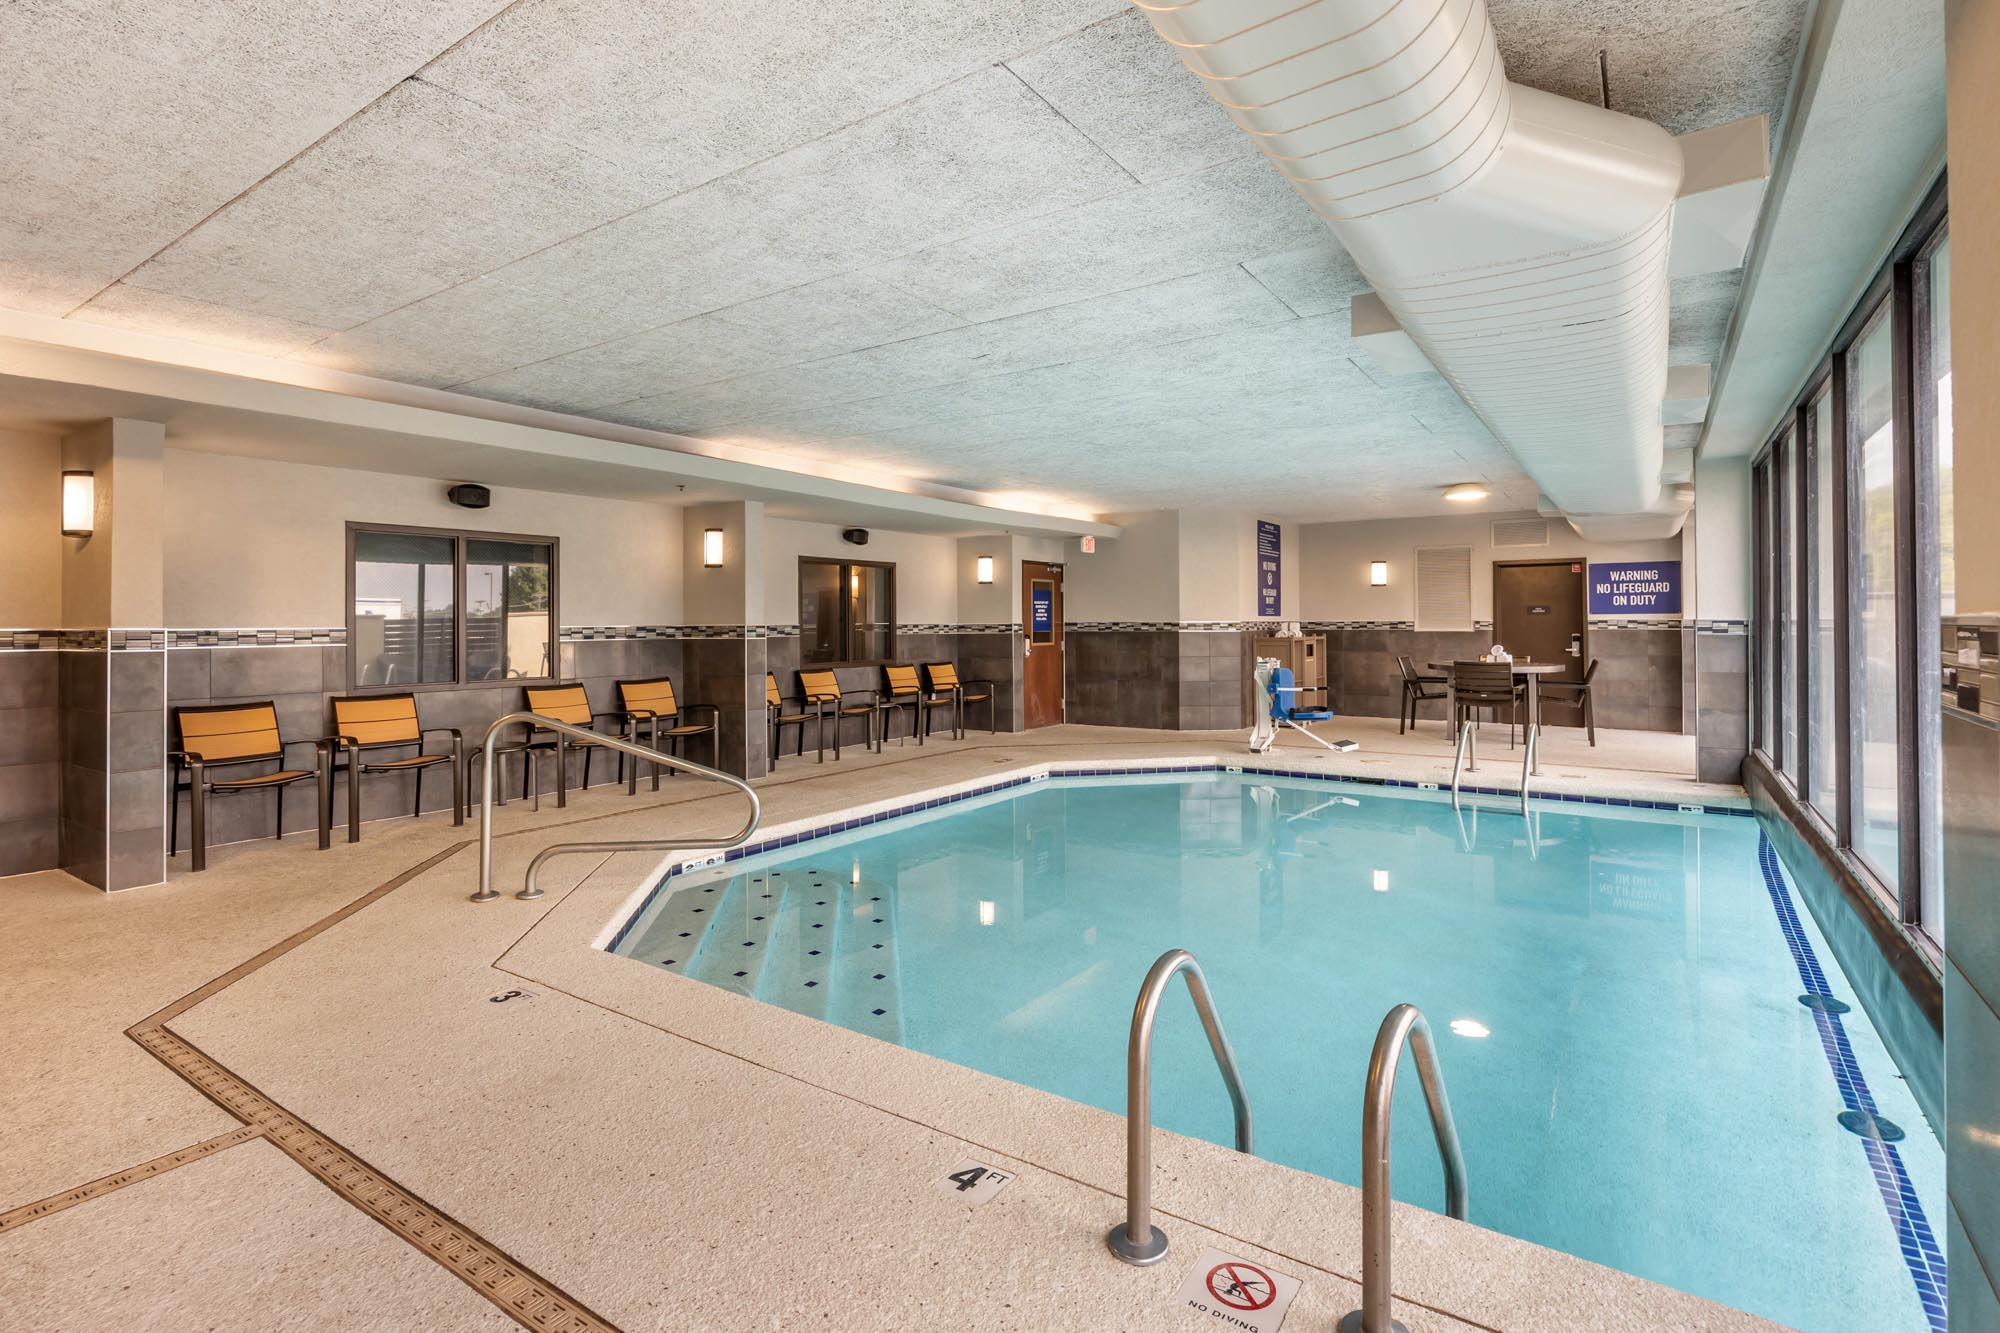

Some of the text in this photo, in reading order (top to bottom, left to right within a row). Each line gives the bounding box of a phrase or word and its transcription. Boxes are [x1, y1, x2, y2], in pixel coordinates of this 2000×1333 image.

[1610, 570, 1659, 581] WARNING
[1596, 582, 1670, 594] NO LIFEGUARD
[1613, 594, 1657, 606] ON DUTY
[489, 991, 522, 1003] 3
[947, 1166, 1010, 1192] 4 FT
[1188, 1300, 1259, 1333] NO DIVING
